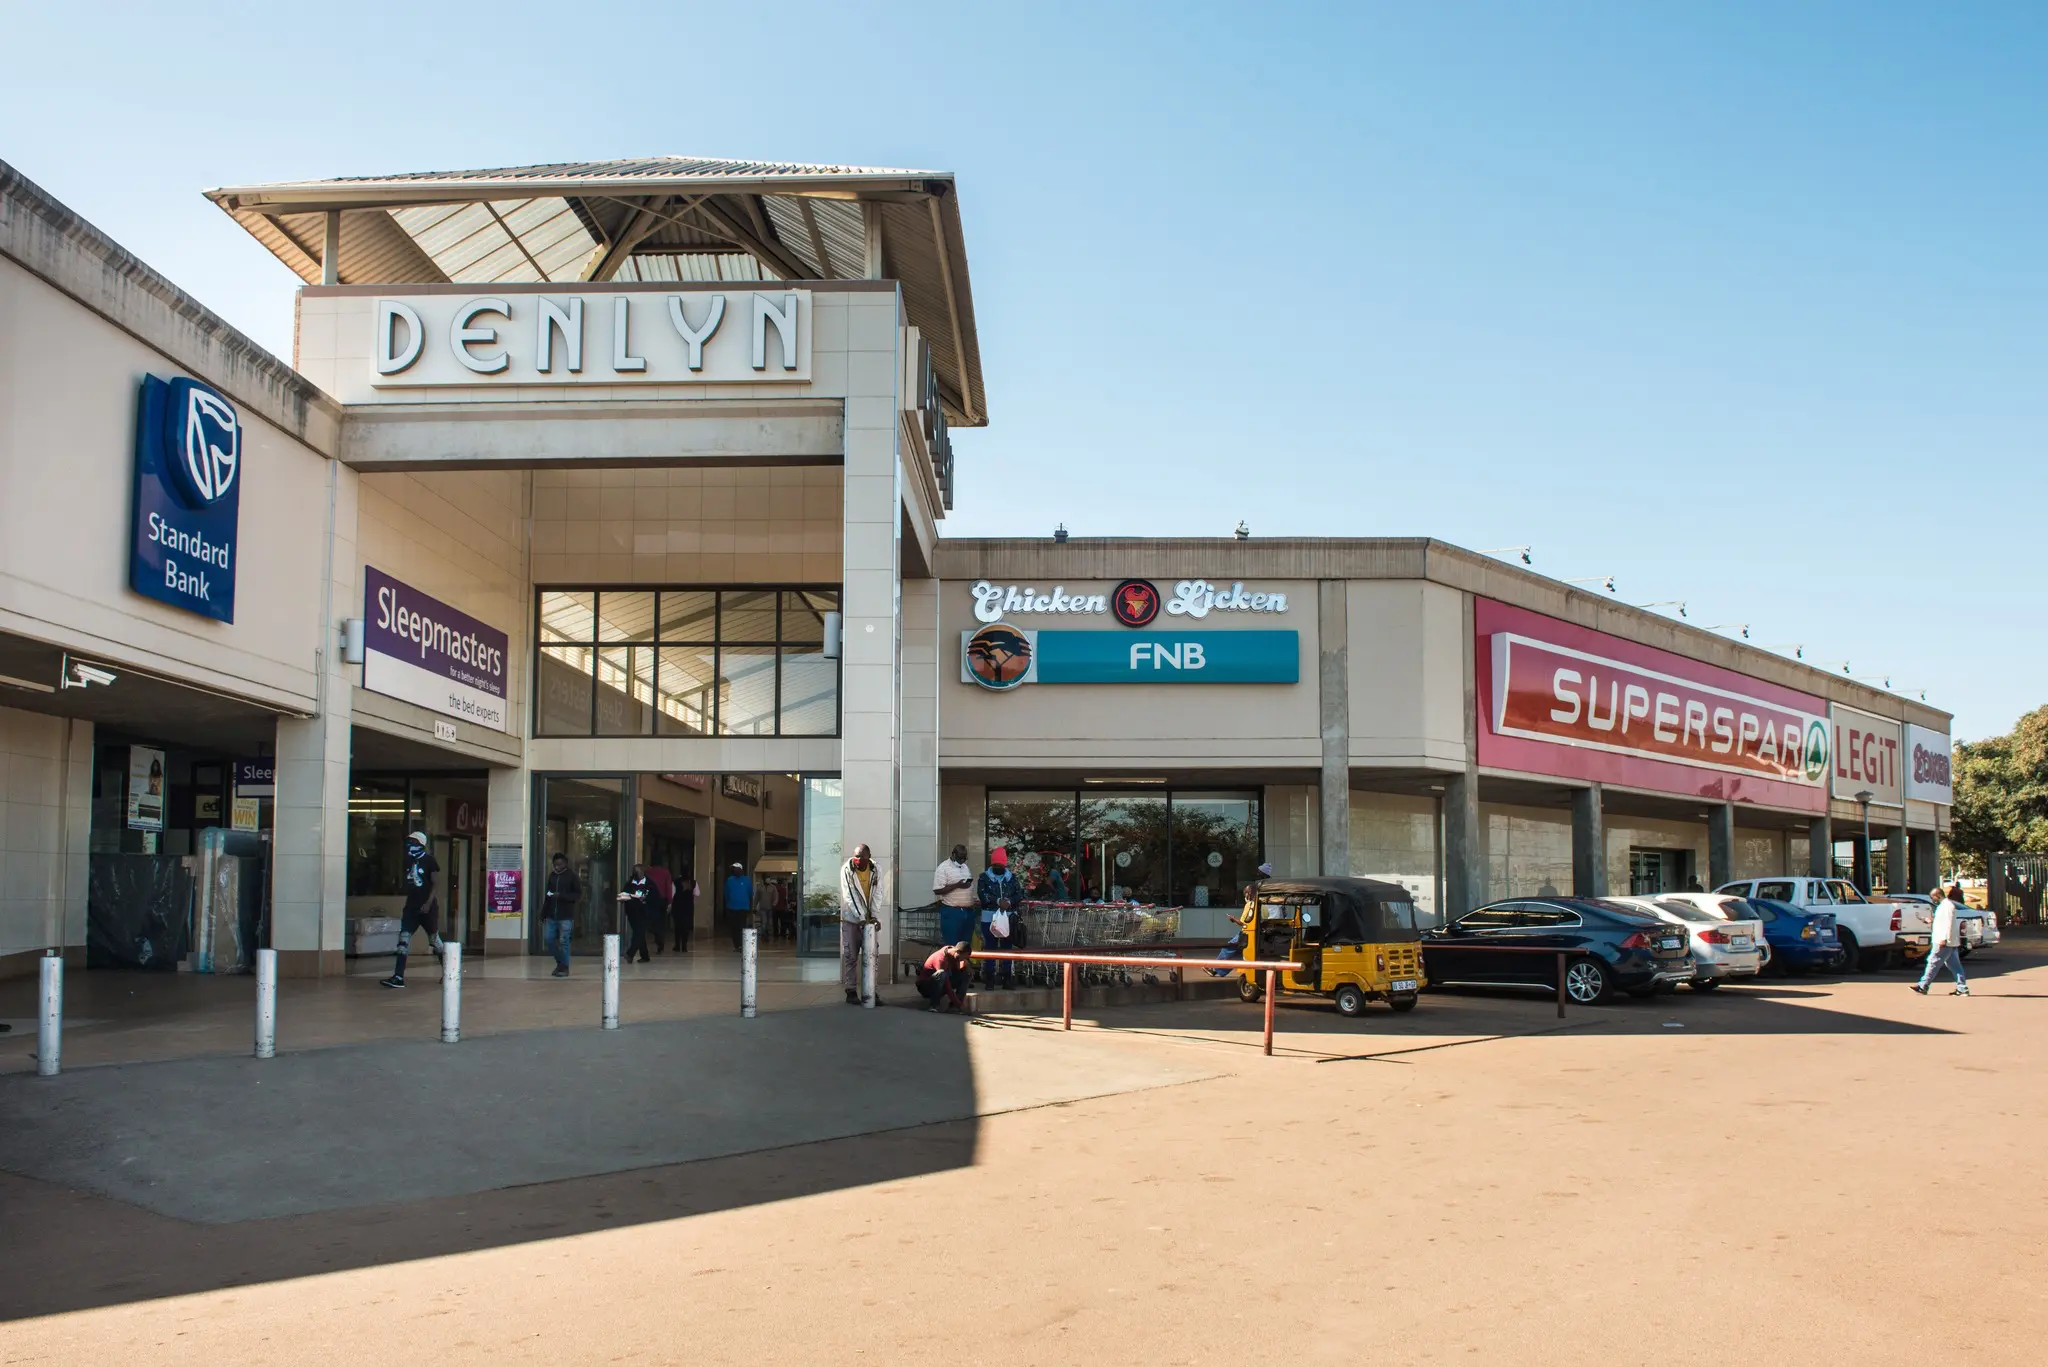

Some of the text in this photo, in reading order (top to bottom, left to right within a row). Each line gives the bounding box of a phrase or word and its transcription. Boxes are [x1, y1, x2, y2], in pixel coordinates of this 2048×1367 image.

[378, 293, 799, 376] DENLYN
[148, 511, 229, 570] Standard
[165, 558, 211, 601] Bank
[969, 580, 1288, 623] Chicken Licken
[377, 586, 501, 677] Sleepmasters
[1130, 642, 1206, 670] FNB
[449, 665, 457, 678] for
[461, 669, 475, 684] better
[489, 681, 501, 695] sleep
[448, 692, 500, 723] the bed experts
[1550, 667, 1801, 768] SUPERSPAR
[243, 765, 275, 783] Slee
[234, 808, 257, 827] WIN
